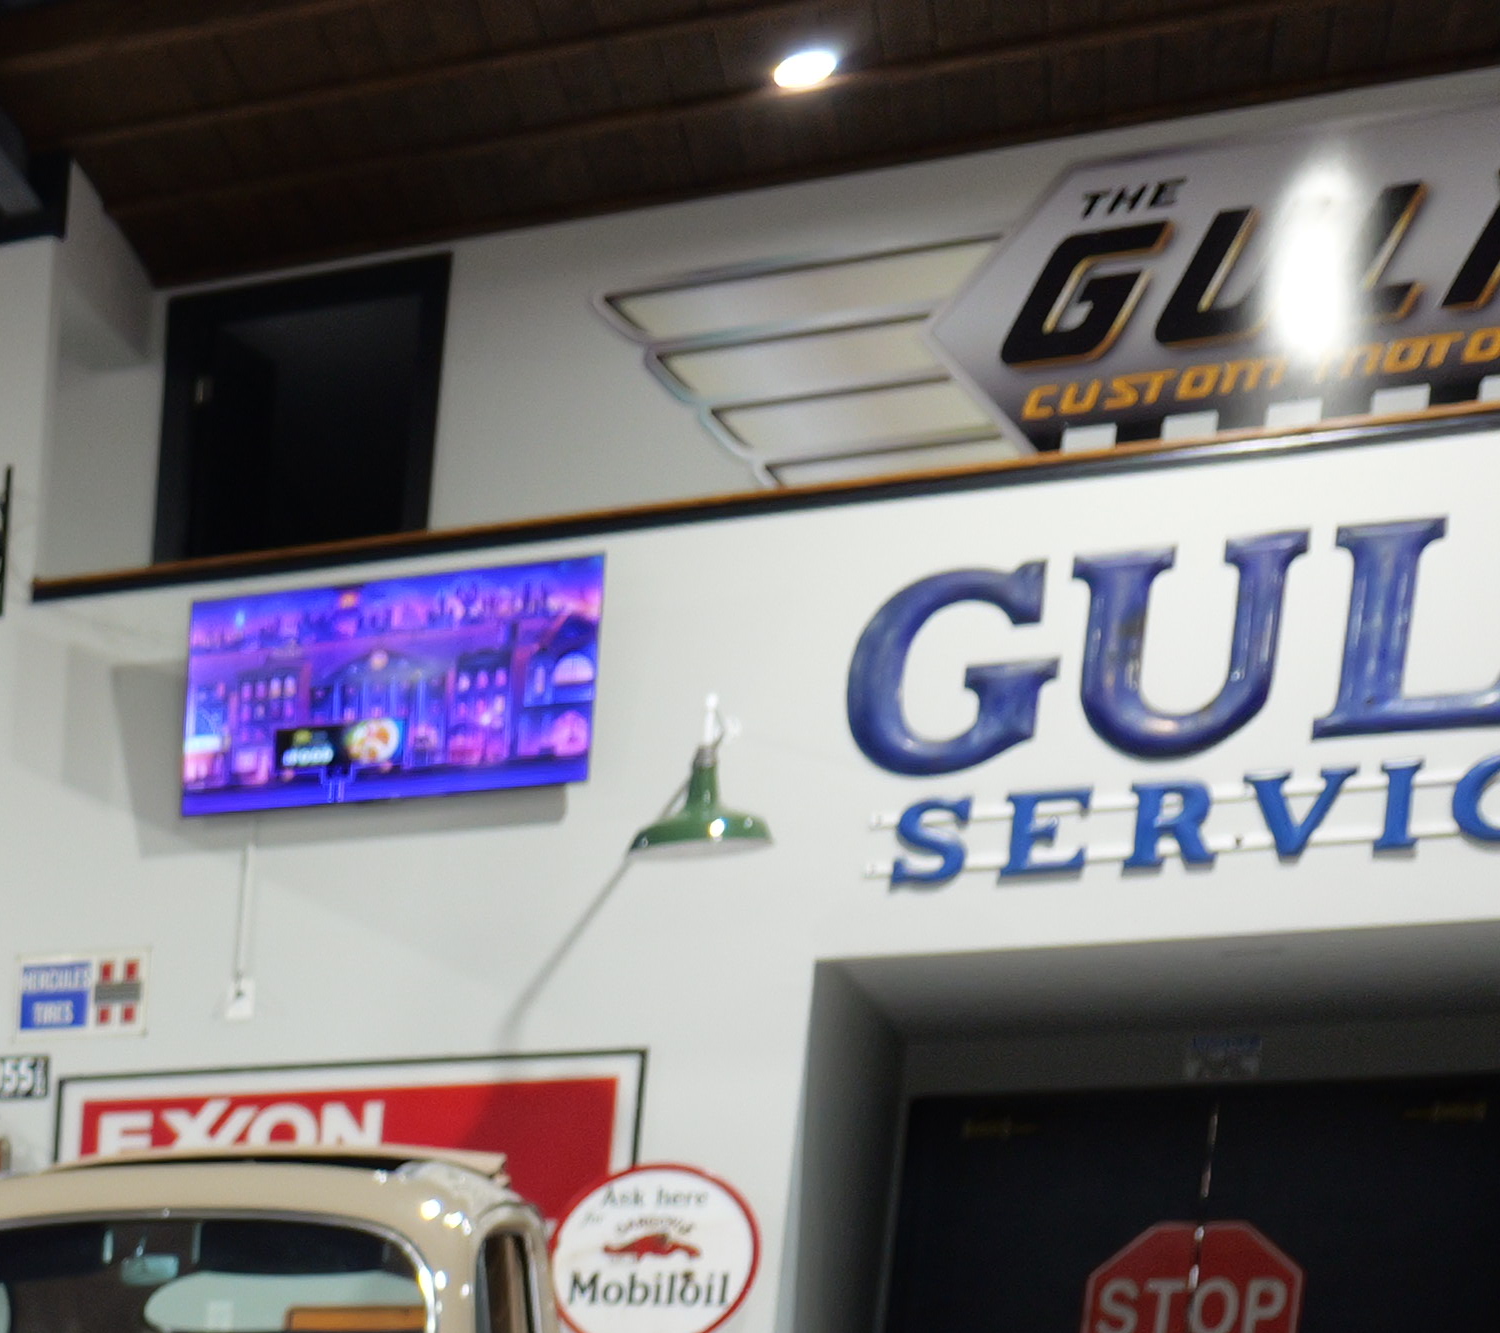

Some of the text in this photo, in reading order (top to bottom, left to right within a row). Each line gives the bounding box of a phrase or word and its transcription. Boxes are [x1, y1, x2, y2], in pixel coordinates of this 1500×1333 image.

[1081, 175, 1188, 219] THE
[999, 178, 1500, 369] GUL
[1021, 326, 1500, 421] CUSTOM MOTO
[846, 516, 1500, 777] GUL
[891, 752, 1500, 889] SERVIC
[33, 1001, 75, 1026] TIRES
[97, 1097, 385, 1155] EXXON
